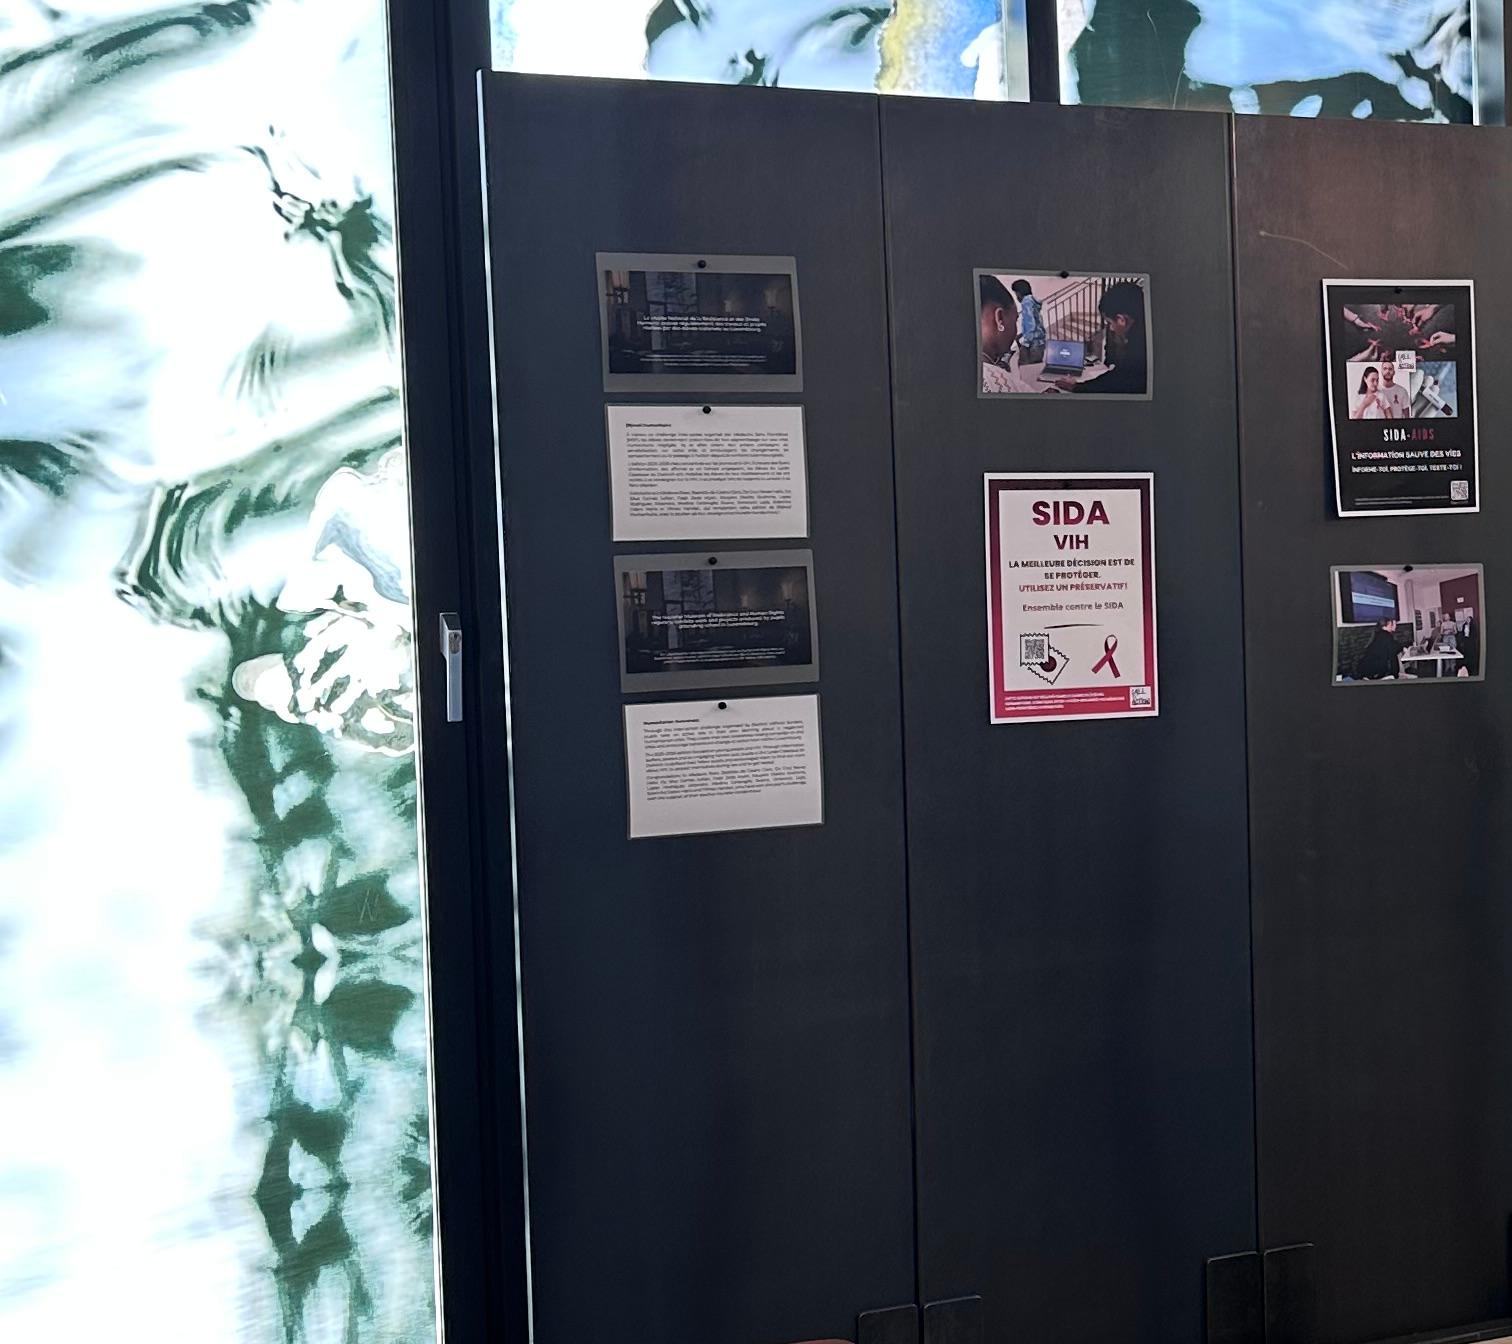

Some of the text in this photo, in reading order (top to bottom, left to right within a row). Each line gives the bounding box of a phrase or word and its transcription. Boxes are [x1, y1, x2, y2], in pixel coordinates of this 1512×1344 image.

[1032, 500, 1110, 526] SIDA
[1053, 534, 1089, 550] VIH
[1008, 557, 1135, 569] LA MEILLEURE DÉCISION EST DE
[1019, 584, 1055, 593] UTILISEZ
[1056, 583, 1069, 592] UN
[1022, 601, 1124, 612] Ensemble contre le SIDA
